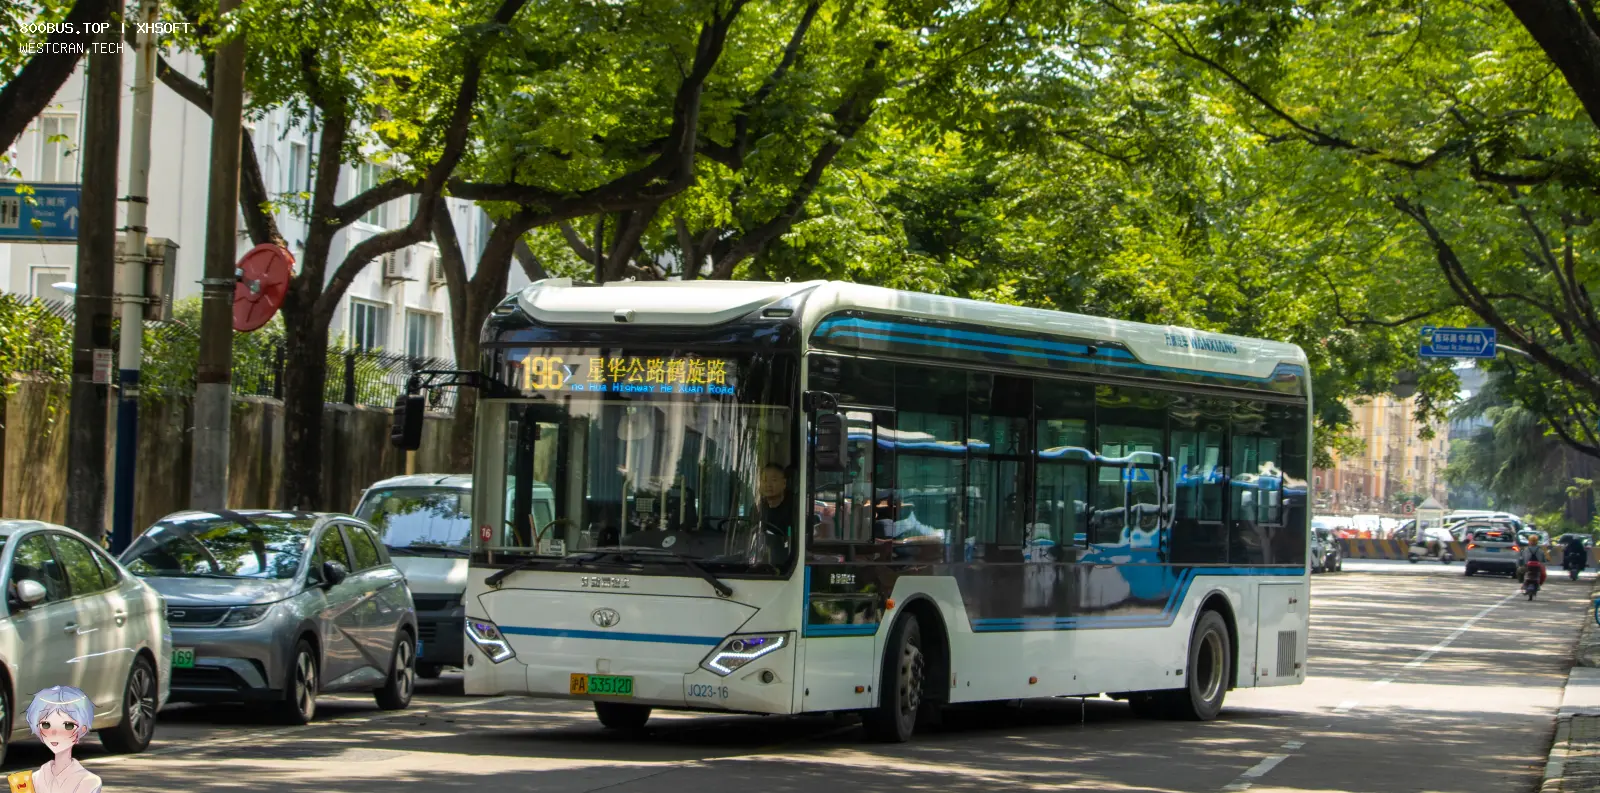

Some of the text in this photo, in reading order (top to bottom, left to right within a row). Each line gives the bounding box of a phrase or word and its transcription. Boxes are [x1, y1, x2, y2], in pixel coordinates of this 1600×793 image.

[1190, 335, 1237, 354] WANXIANG
[521, 355, 564, 390] 196
[586, 357, 727, 385] 星华公路鹤旋路
[589, 384, 607, 392] Hua
[612, 384, 655, 393] Highway
[660, 384, 673, 392] He
[678, 384, 704, 393] Xuan
[708, 385, 735, 394] Road
[481, 528, 492, 539] 16
[688, 684, 729, 699] JQ23-16
